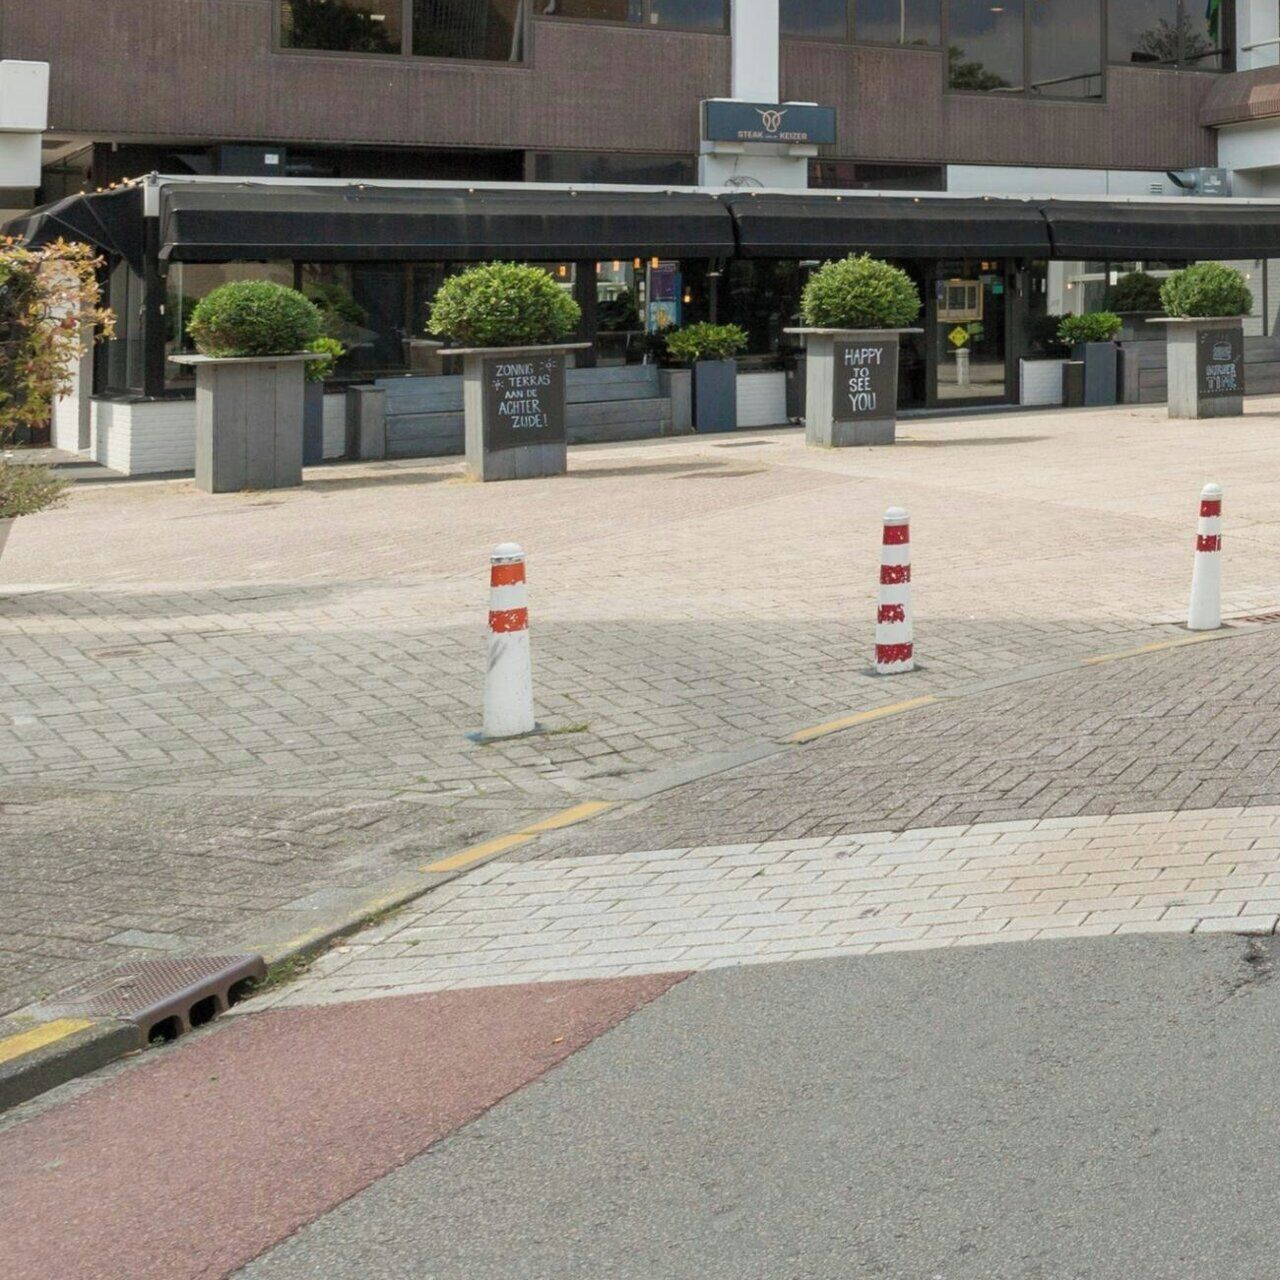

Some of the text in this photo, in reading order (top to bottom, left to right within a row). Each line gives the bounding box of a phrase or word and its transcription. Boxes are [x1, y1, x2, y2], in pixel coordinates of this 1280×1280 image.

[737, 131, 763, 139] STEAK
[780, 132, 808, 140] KEIZER
[844, 348, 883, 366] HAPPY
[496, 363, 534, 377] ZONNIG
[853, 367, 869, 378] TO
[508, 374, 551, 387] TERRAS
[848, 377, 871, 392] SEE
[504, 389, 538, 399] AAN DE
[498, 399, 541, 415] ACHTER
[848, 392, 876, 412] YOU
